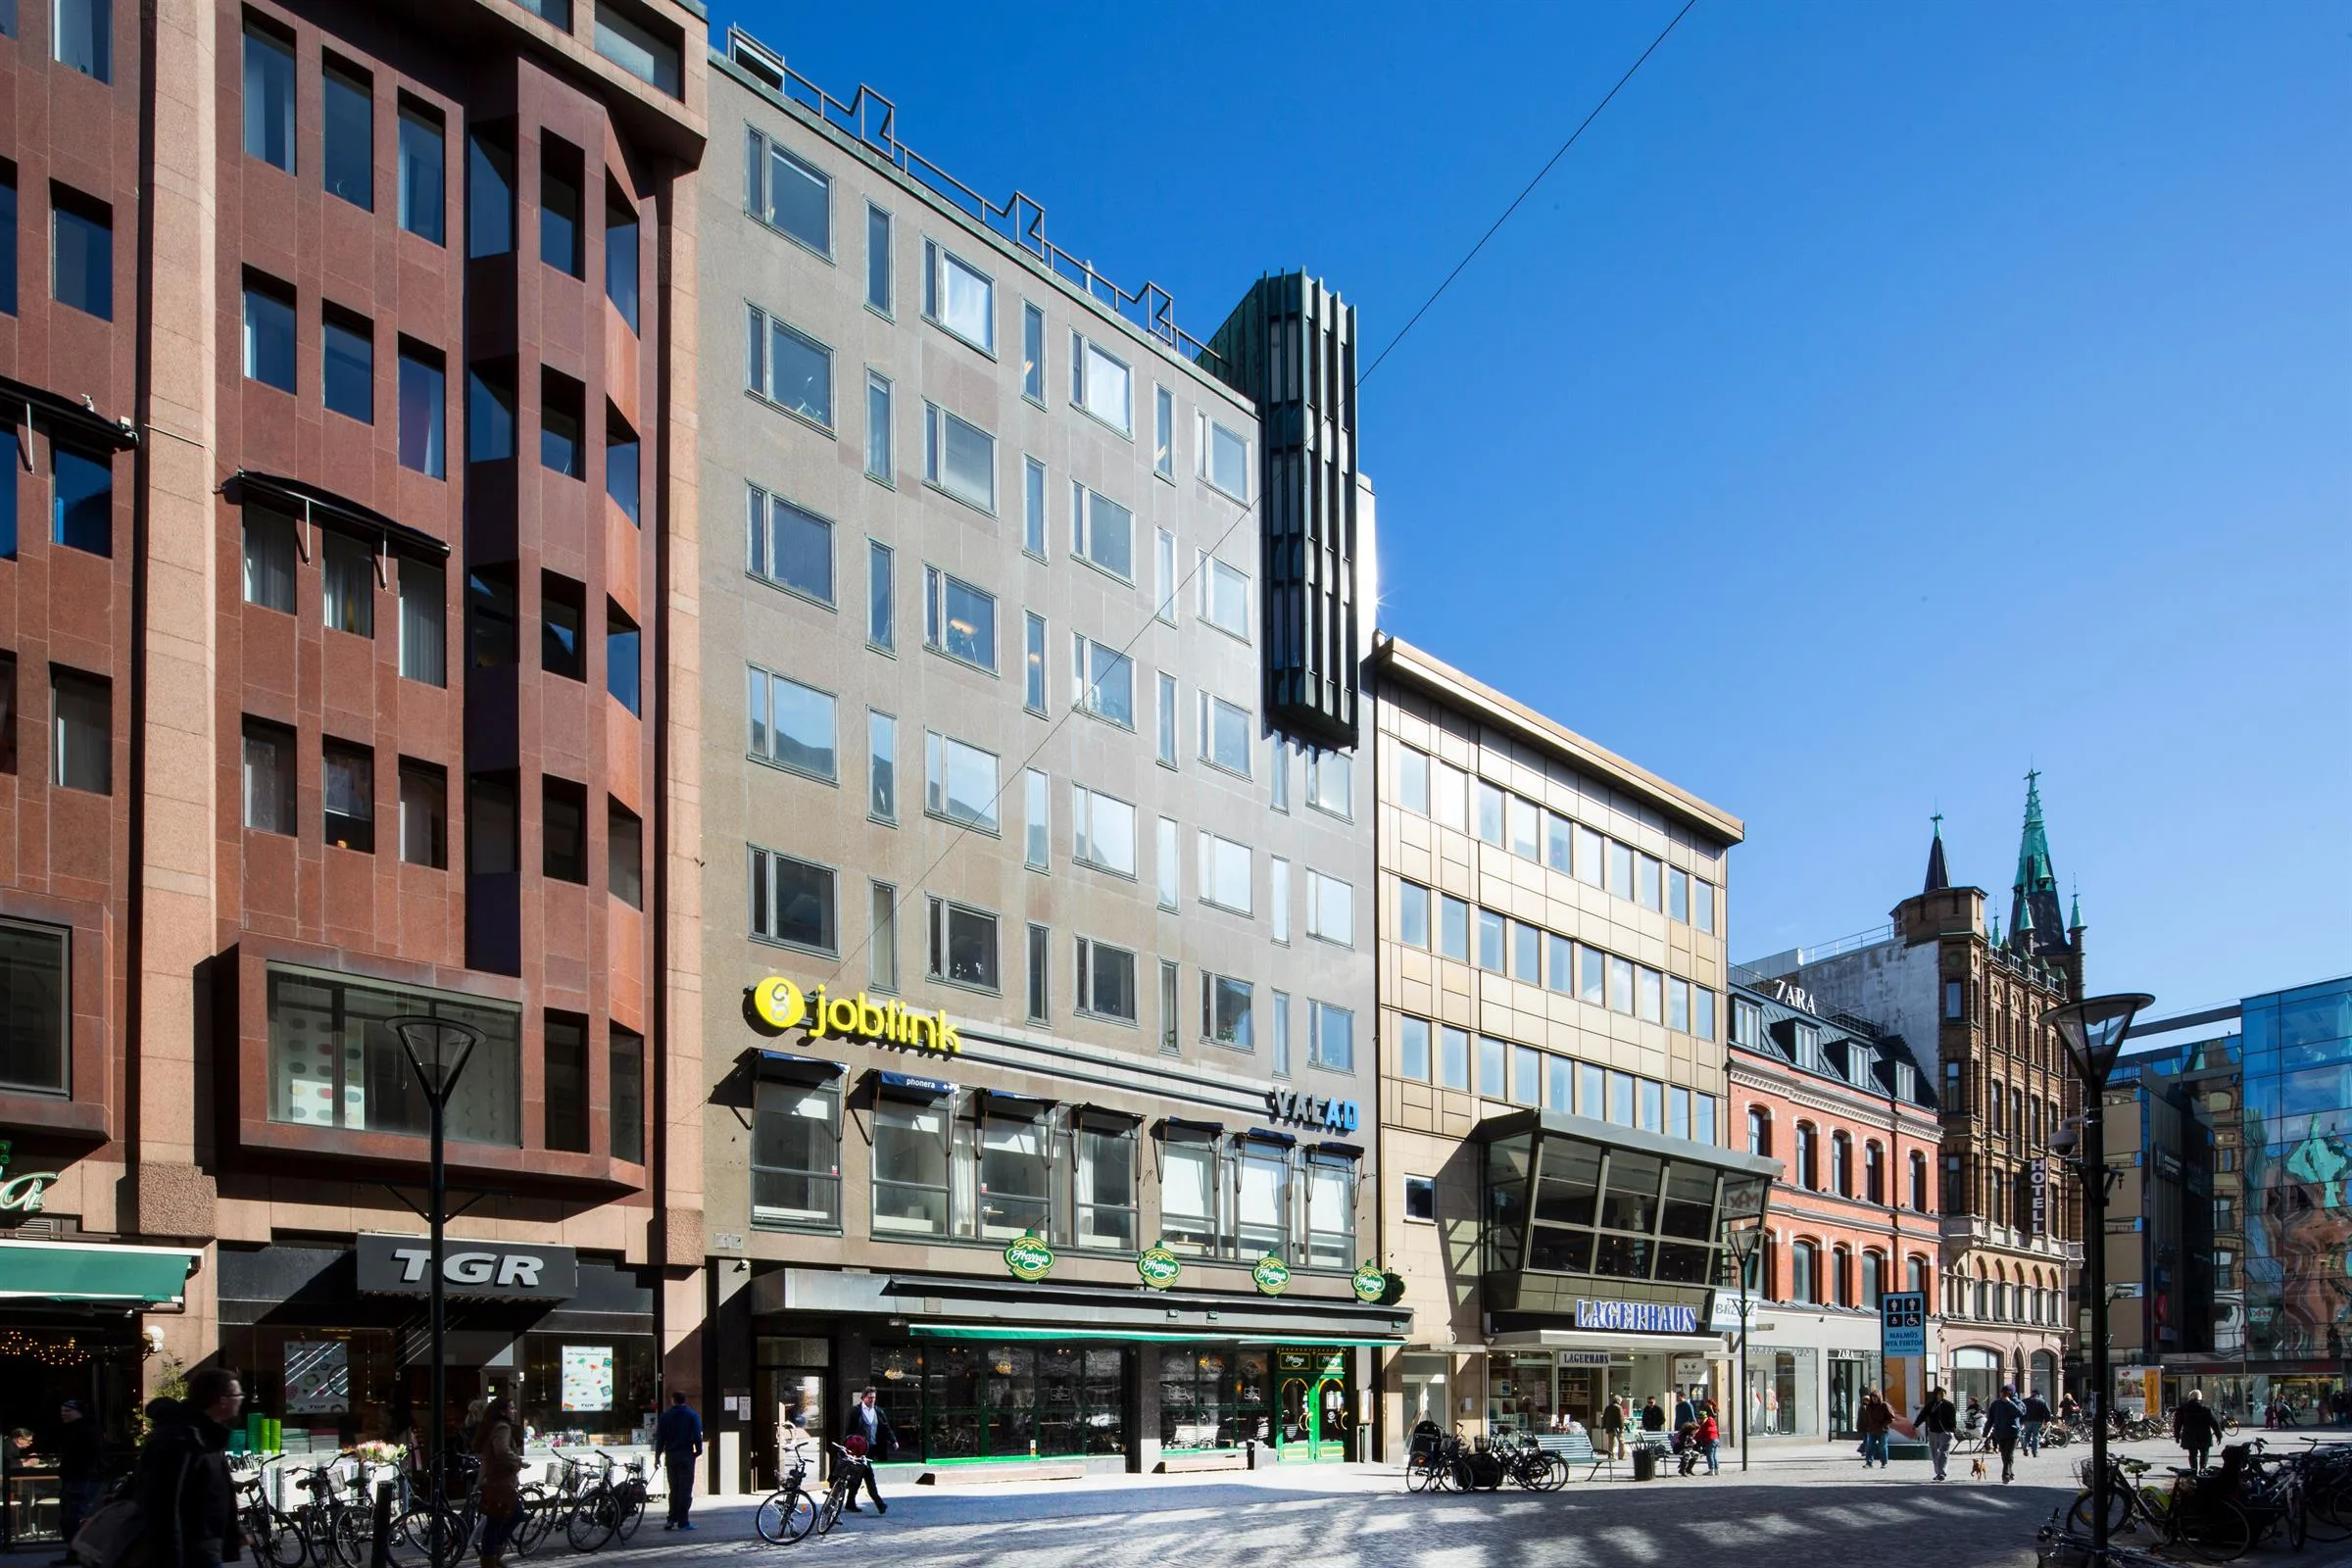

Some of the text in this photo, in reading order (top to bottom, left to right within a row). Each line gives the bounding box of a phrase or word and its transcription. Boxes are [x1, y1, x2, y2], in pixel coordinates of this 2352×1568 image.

[1774, 979, 1816, 1015] ZARA
[808, 984, 961, 1054] joblink
[906, 1078, 936, 1089] phonera
[1273, 1086, 1359, 1130] VALAD
[2031, 1159, 2045, 1234] HOTELL
[394, 1248, 544, 1286] TGR
[1010, 1250, 1049, 1270] Harrys
[1144, 1259, 1176, 1279] Harrys
[1576, 1299, 1696, 1333] LAGERHAUS
[1564, 1353, 1609, 1364] LAGERHAUS
[1838, 1349, 1854, 1359] ZARA
